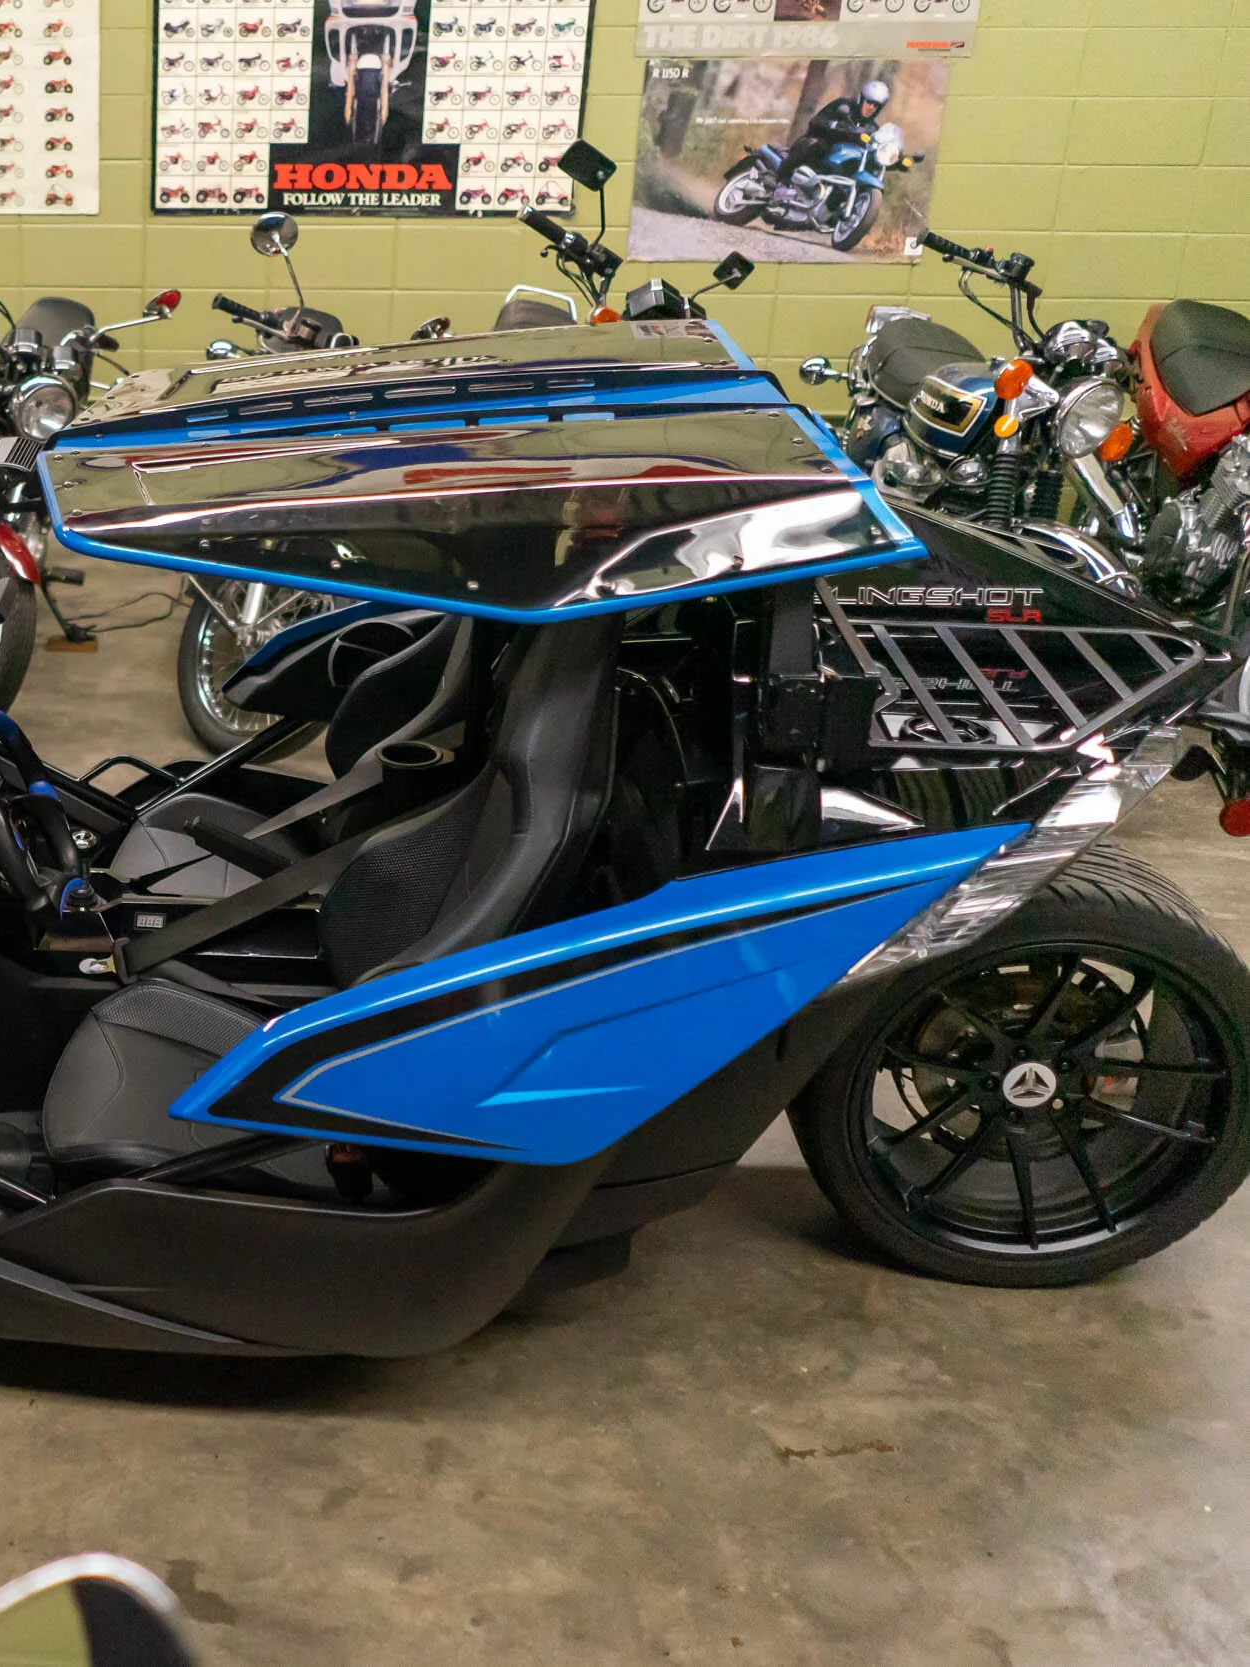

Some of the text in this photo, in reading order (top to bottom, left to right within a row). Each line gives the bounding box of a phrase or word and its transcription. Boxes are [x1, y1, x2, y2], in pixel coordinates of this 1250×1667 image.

[644, 24, 840, 49] THE DIRT 1986
[652, 67, 690, 79] R 1150 R
[273, 162, 453, 190] HONDA
[283, 192, 442, 207] FOLLOW THE LEADER
[986, 608, 1042, 623] SLR
